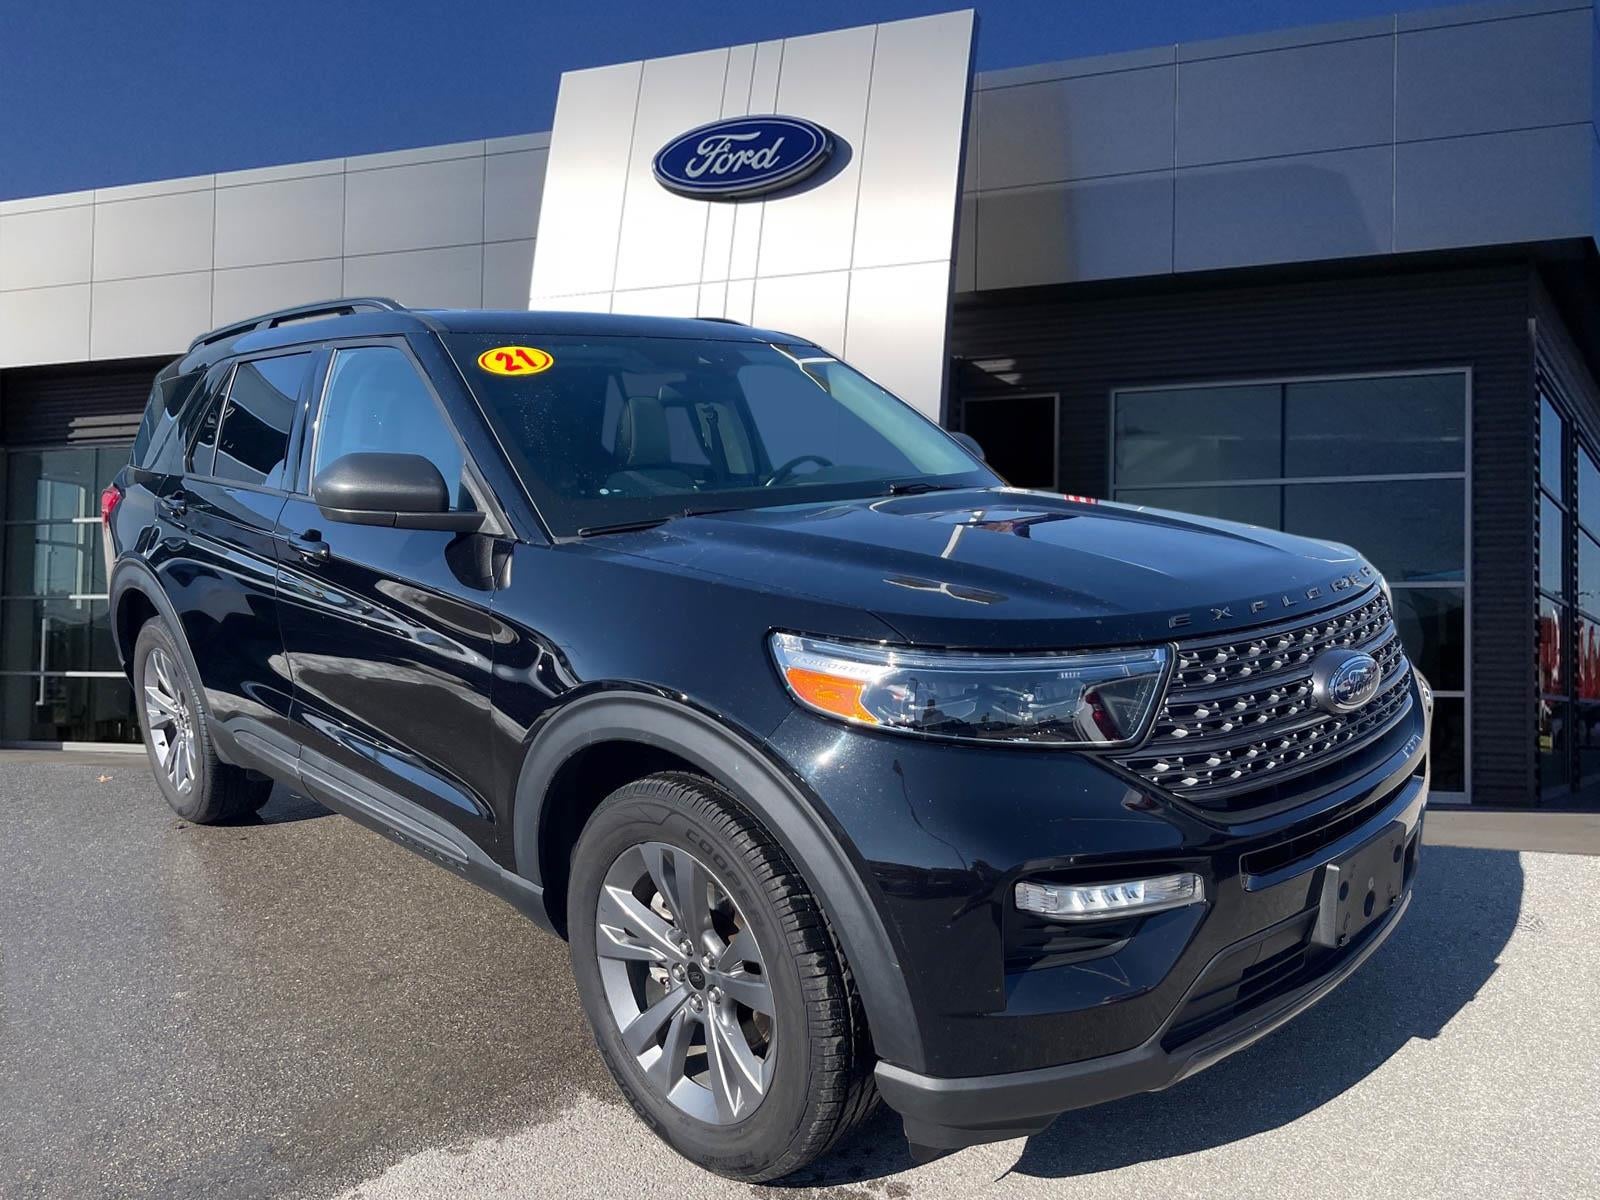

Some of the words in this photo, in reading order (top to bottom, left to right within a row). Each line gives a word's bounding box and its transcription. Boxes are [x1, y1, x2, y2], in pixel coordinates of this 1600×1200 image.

[685, 131, 784, 178] Ford
[495, 349, 537, 372] 21
[1346, 666, 1374, 699] Ford
